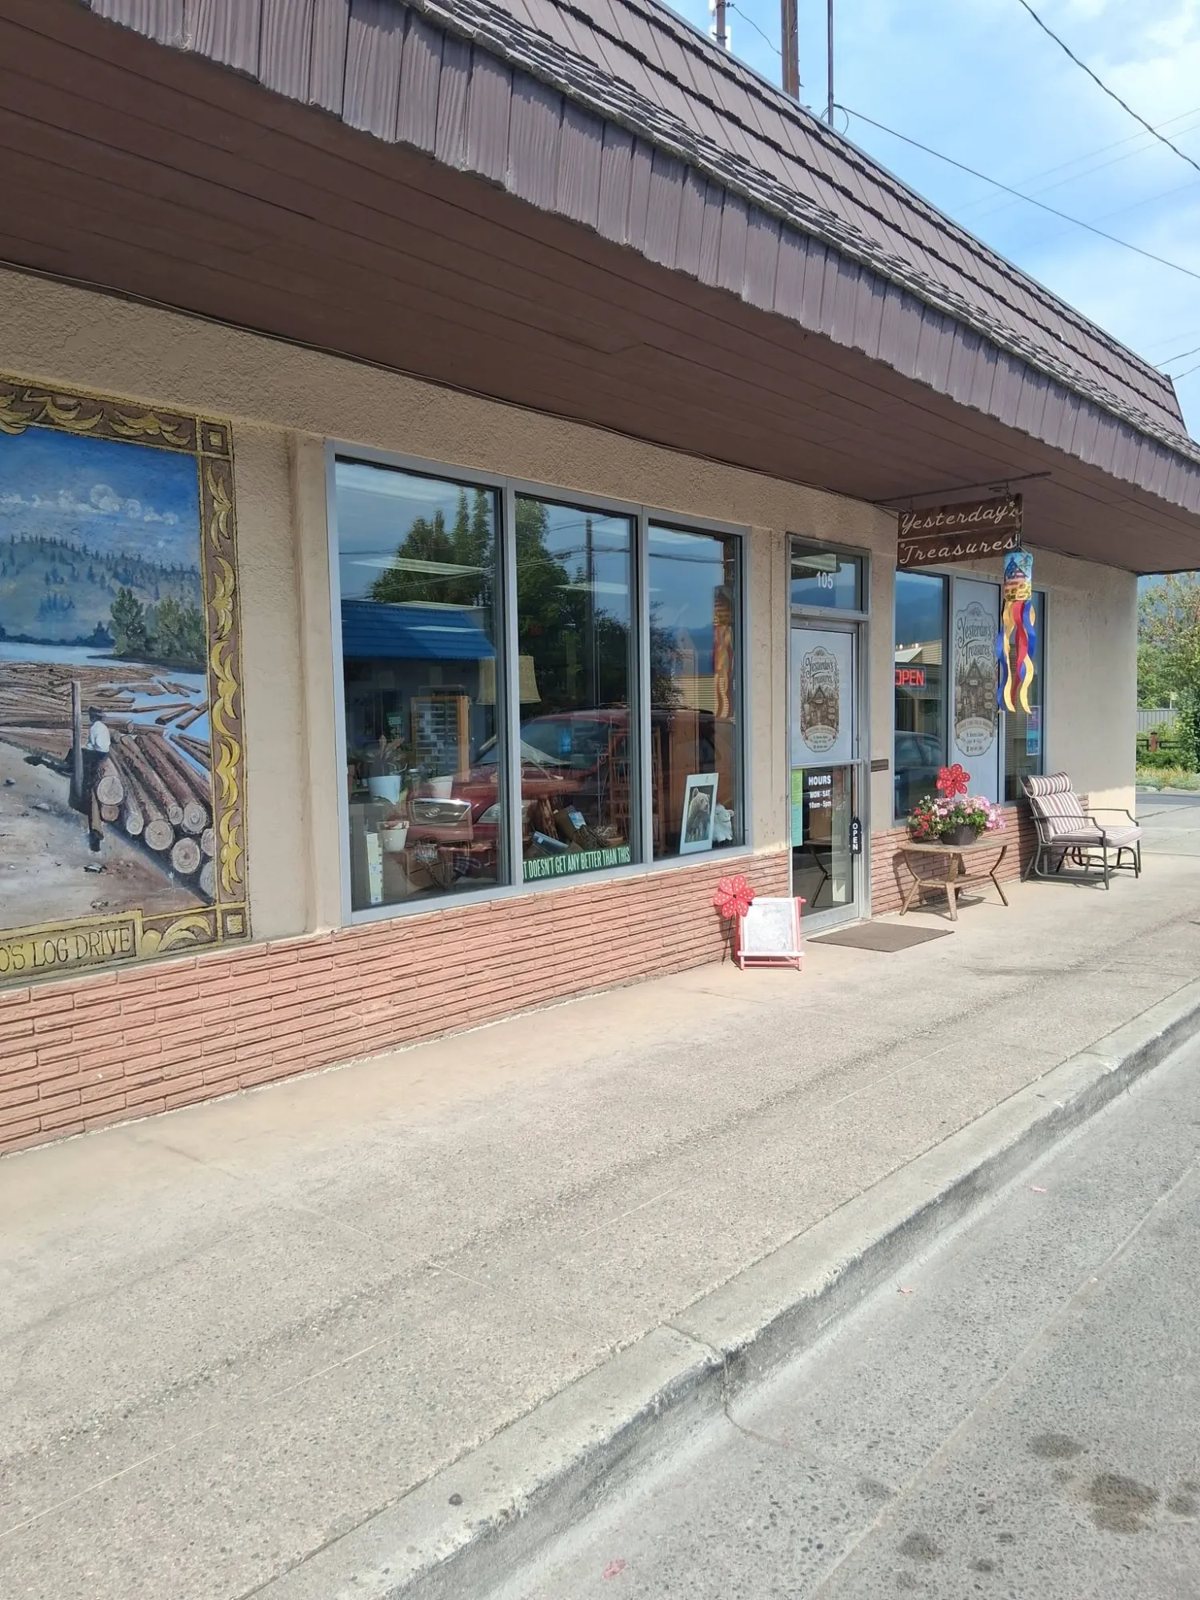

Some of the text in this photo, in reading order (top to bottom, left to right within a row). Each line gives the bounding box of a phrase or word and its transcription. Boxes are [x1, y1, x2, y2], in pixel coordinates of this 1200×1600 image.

[901, 500, 1024, 535] Yesterday's
[900, 537, 1016, 564] Treasures
[816, 571, 834, 590] 105
[895, 669, 925, 686] OPEN
[808, 775, 831, 786] HOURS
[555, 855, 566, 873] GET
[567, 853, 580, 872] ANY
[580, 850, 602, 870] BETTER
[602, 848, 617, 866] THAN
[617, 846, 630, 863] THIS
[30, 937, 69, 968] LOG
[75, 927, 131, 959] DRIVE
